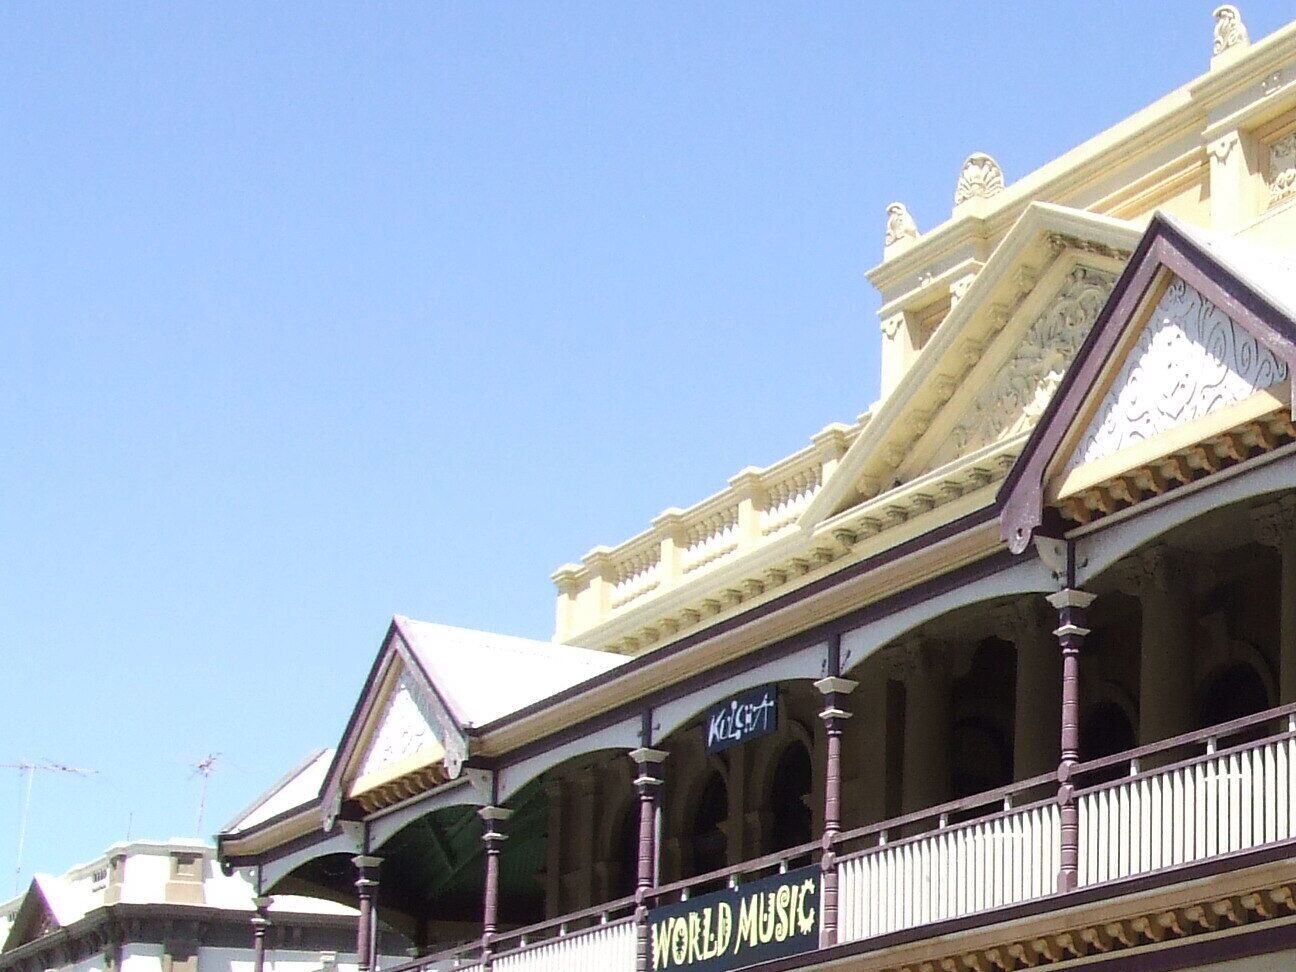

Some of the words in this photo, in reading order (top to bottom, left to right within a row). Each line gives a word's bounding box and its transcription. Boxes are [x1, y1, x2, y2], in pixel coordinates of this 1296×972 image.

[708, 693, 774, 748] KULCHA
[651, 901, 732, 971] WORLD
[734, 878, 816, 955] MUSIC
